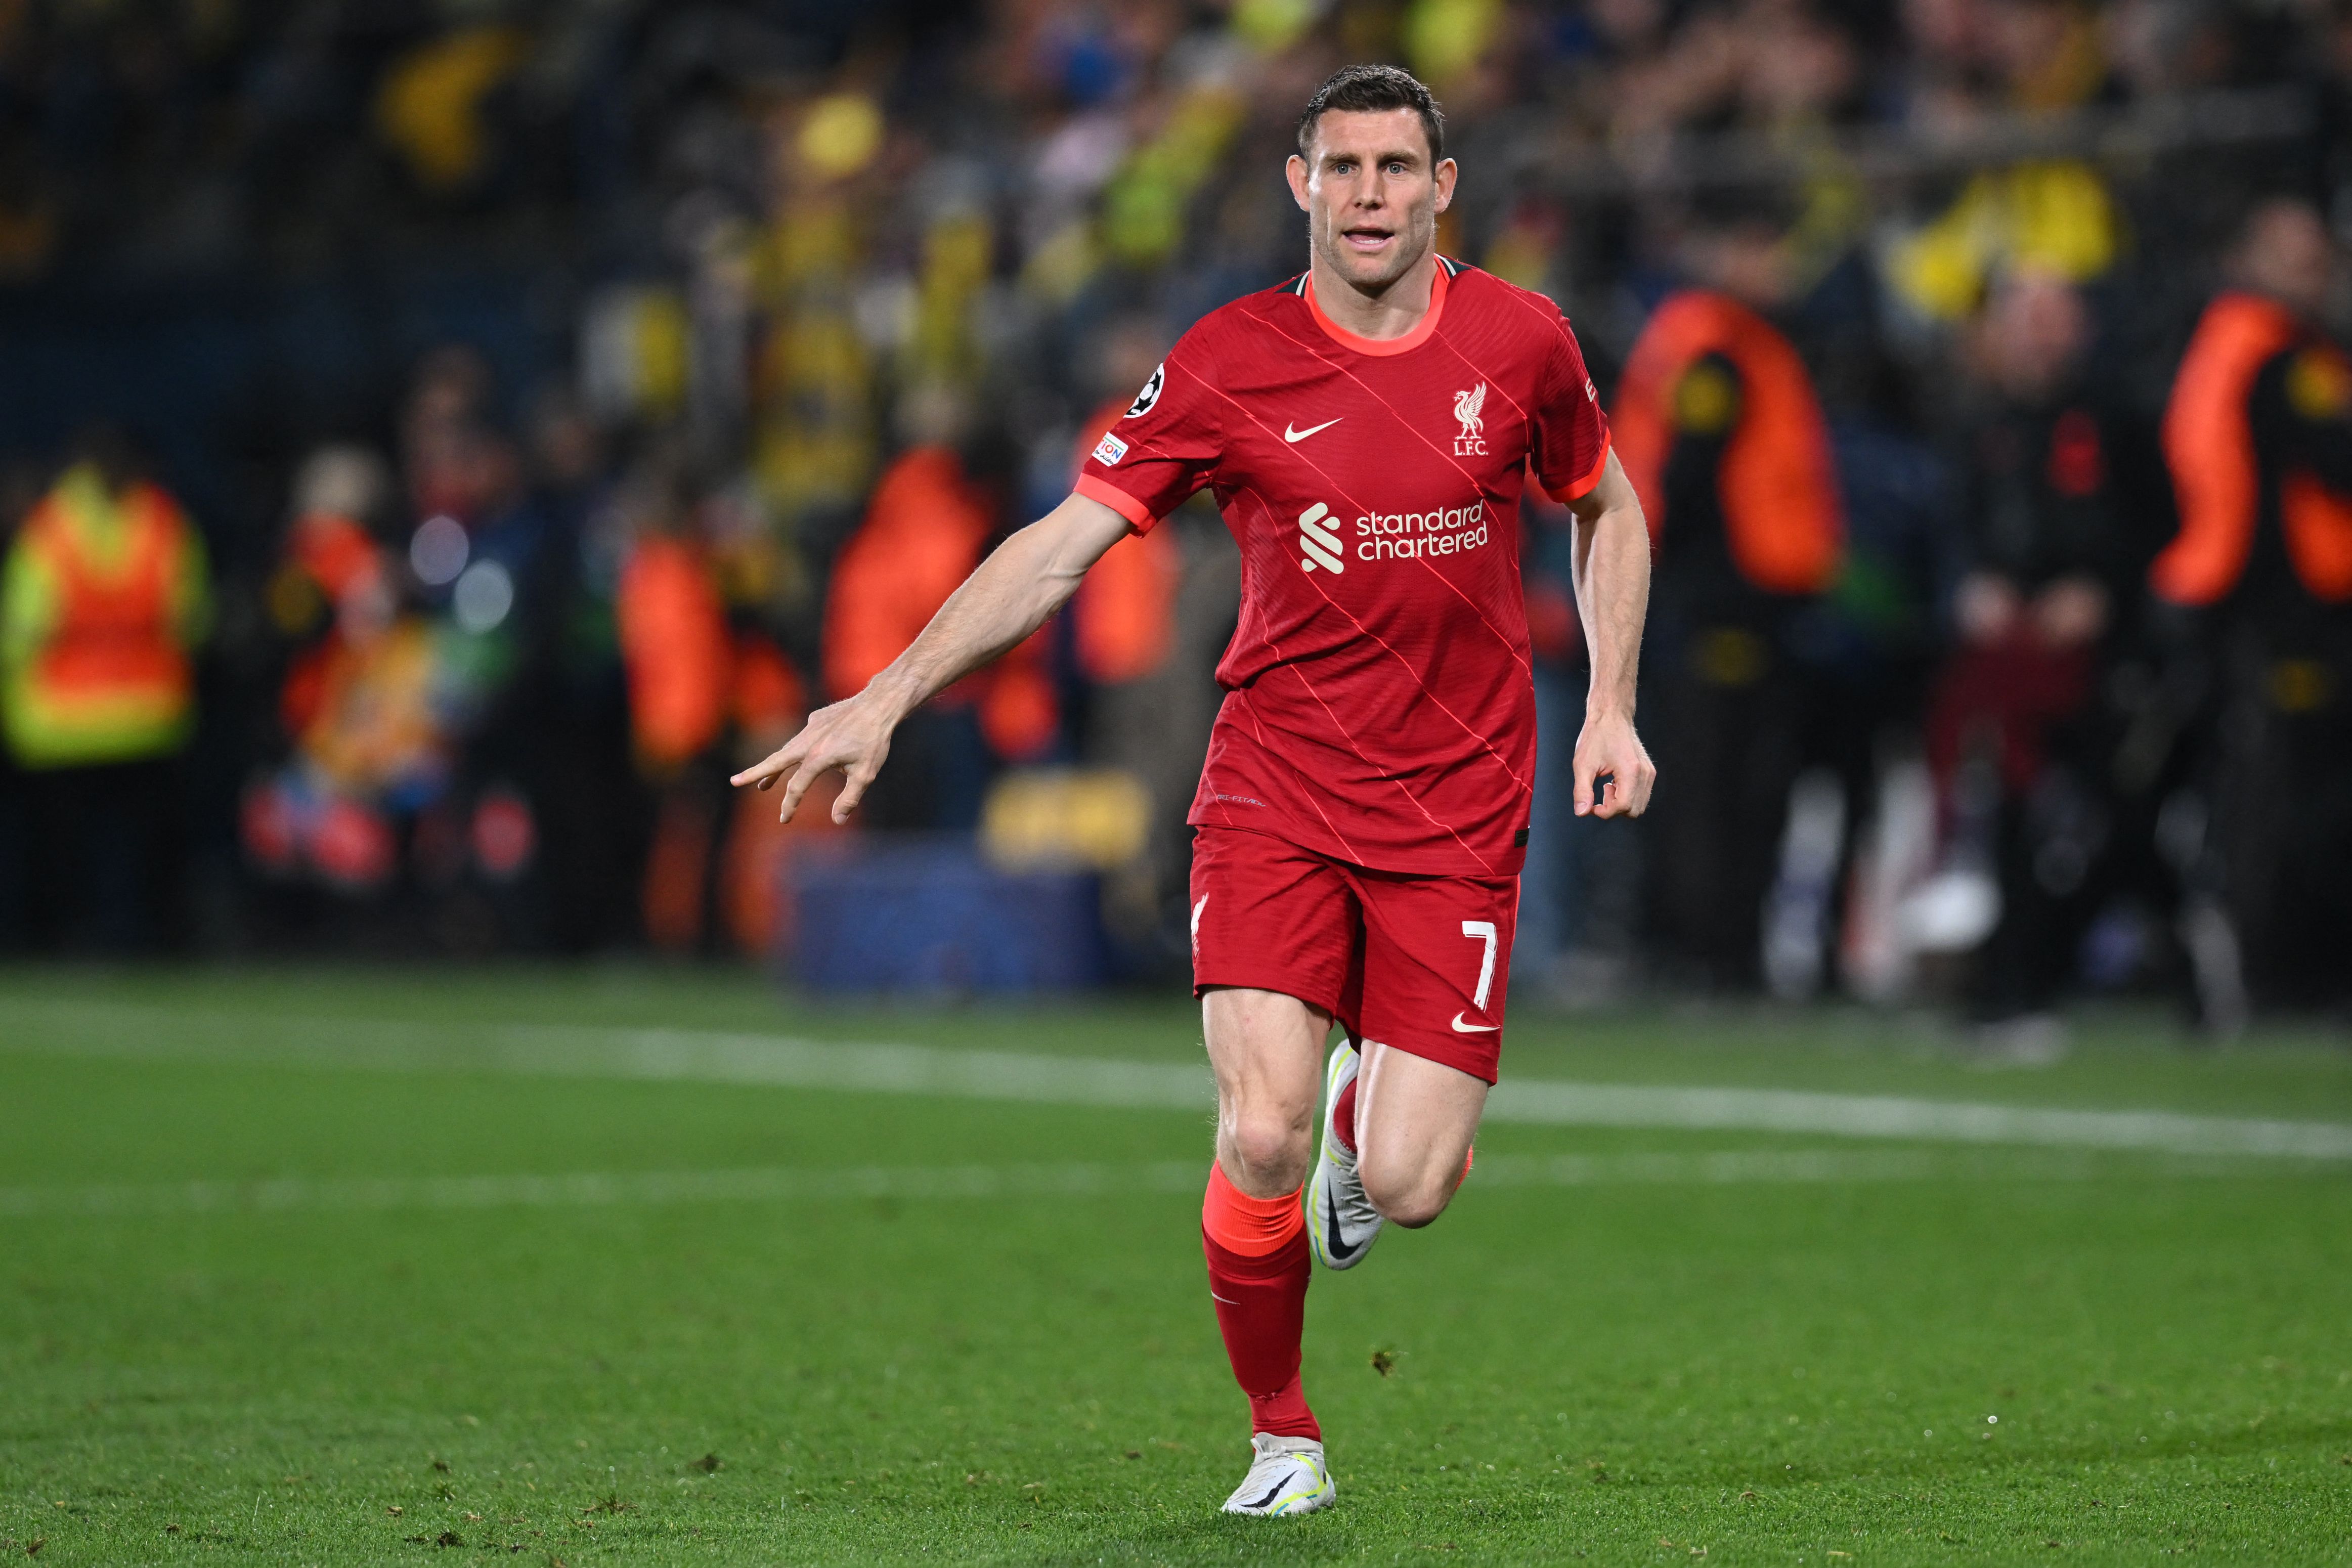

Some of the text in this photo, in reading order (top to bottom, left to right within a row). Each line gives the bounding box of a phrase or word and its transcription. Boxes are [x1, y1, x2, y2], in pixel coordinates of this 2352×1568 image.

[1454, 441, 1489, 456] L.F.C.
[1356, 499, 1484, 536] standard
[1358, 520, 1488, 560] chartered
[1462, 921, 1498, 1013] 7
